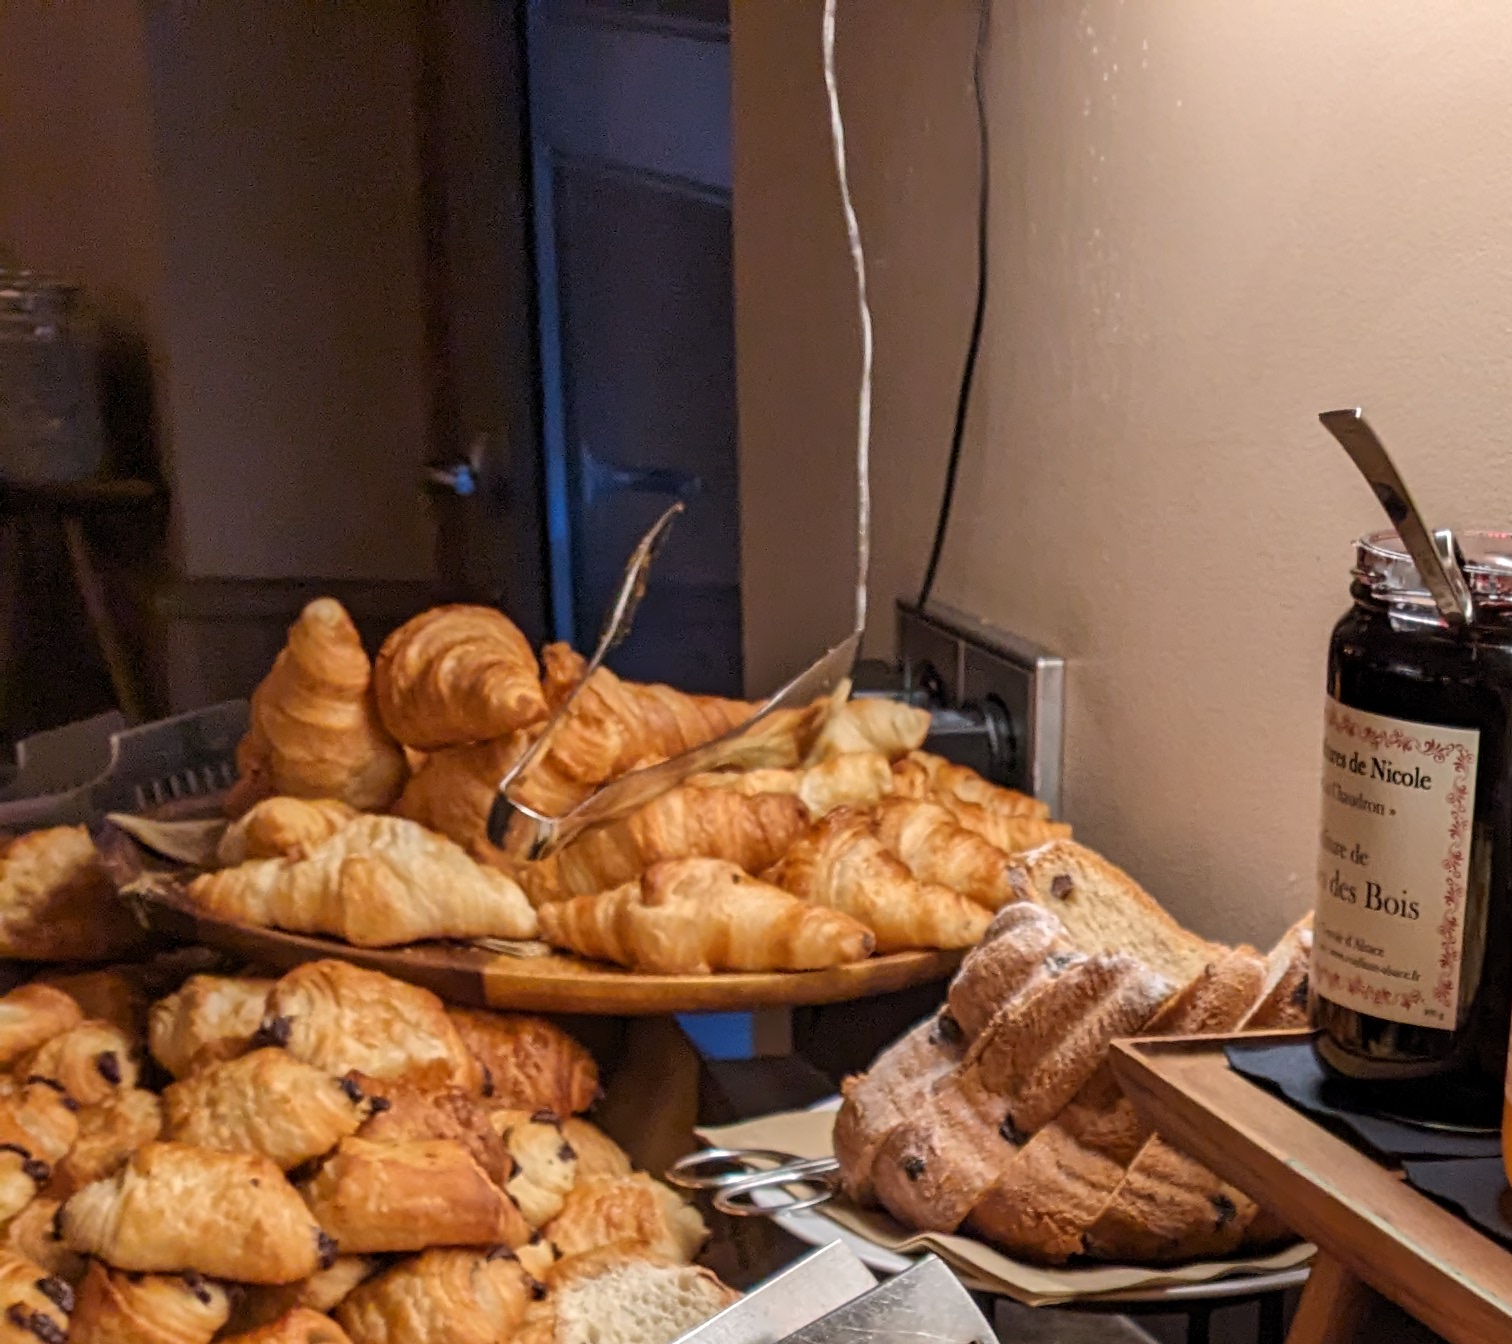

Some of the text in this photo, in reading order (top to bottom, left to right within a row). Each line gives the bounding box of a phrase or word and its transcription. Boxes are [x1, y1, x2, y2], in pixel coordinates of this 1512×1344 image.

[1350, 751, 1367, 775] de
[1371, 757, 1431, 790] Nicole
[1364, 881, 1420, 920] Bois
